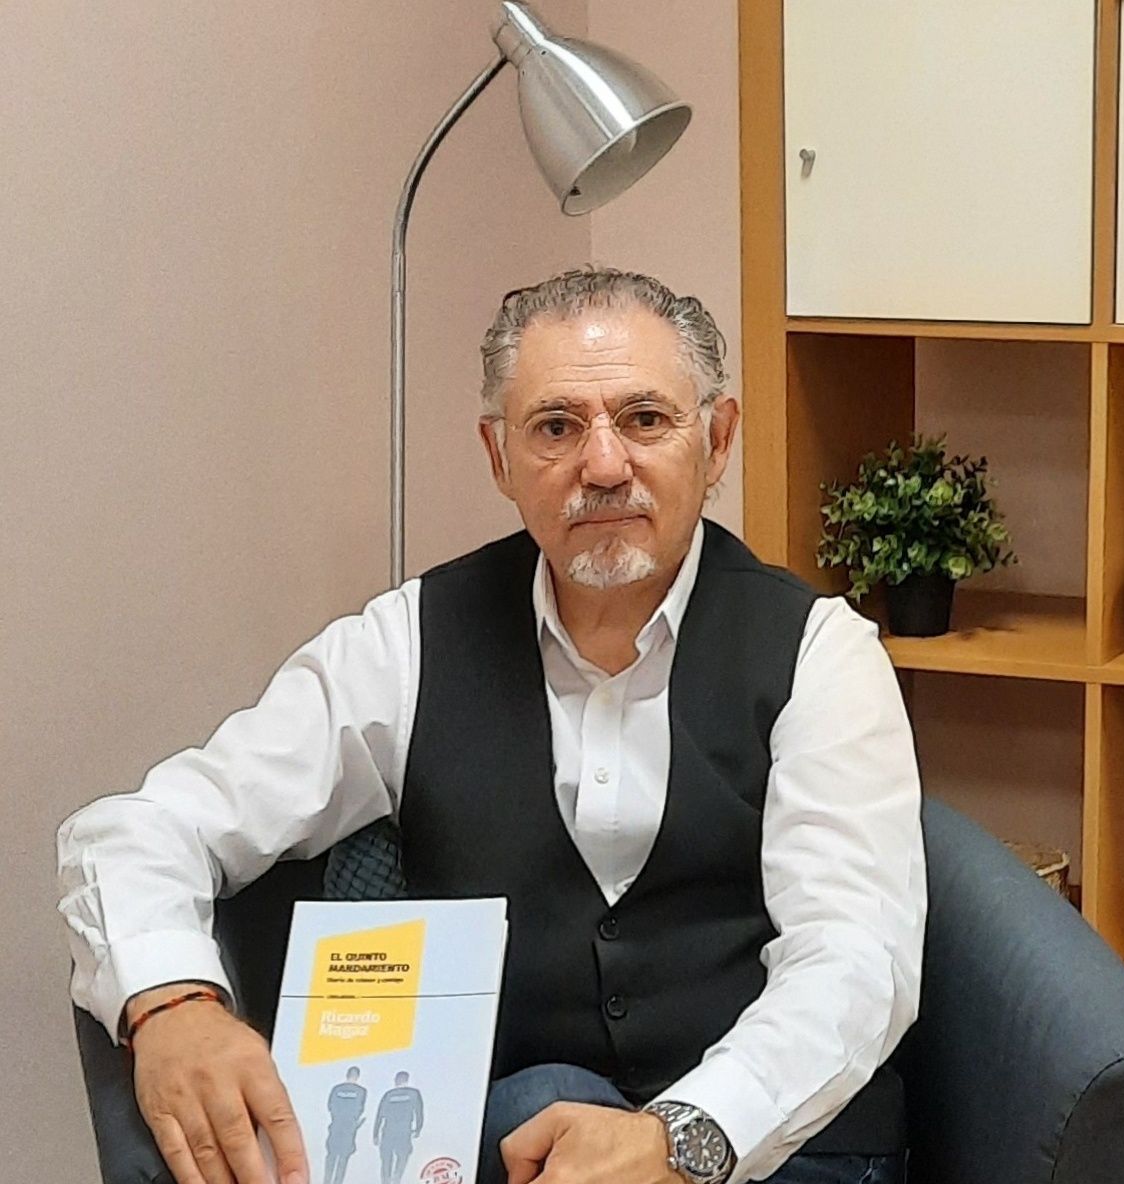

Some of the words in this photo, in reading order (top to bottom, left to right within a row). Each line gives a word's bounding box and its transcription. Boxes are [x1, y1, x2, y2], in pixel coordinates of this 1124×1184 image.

[330, 952, 342, 961] EL
[345, 951, 387, 961] QUINTO
[328, 963, 410, 973] MANDAMIENTO
[320, 1010, 380, 1025] Ricardo
[318, 1023, 369, 1040] Magaz
